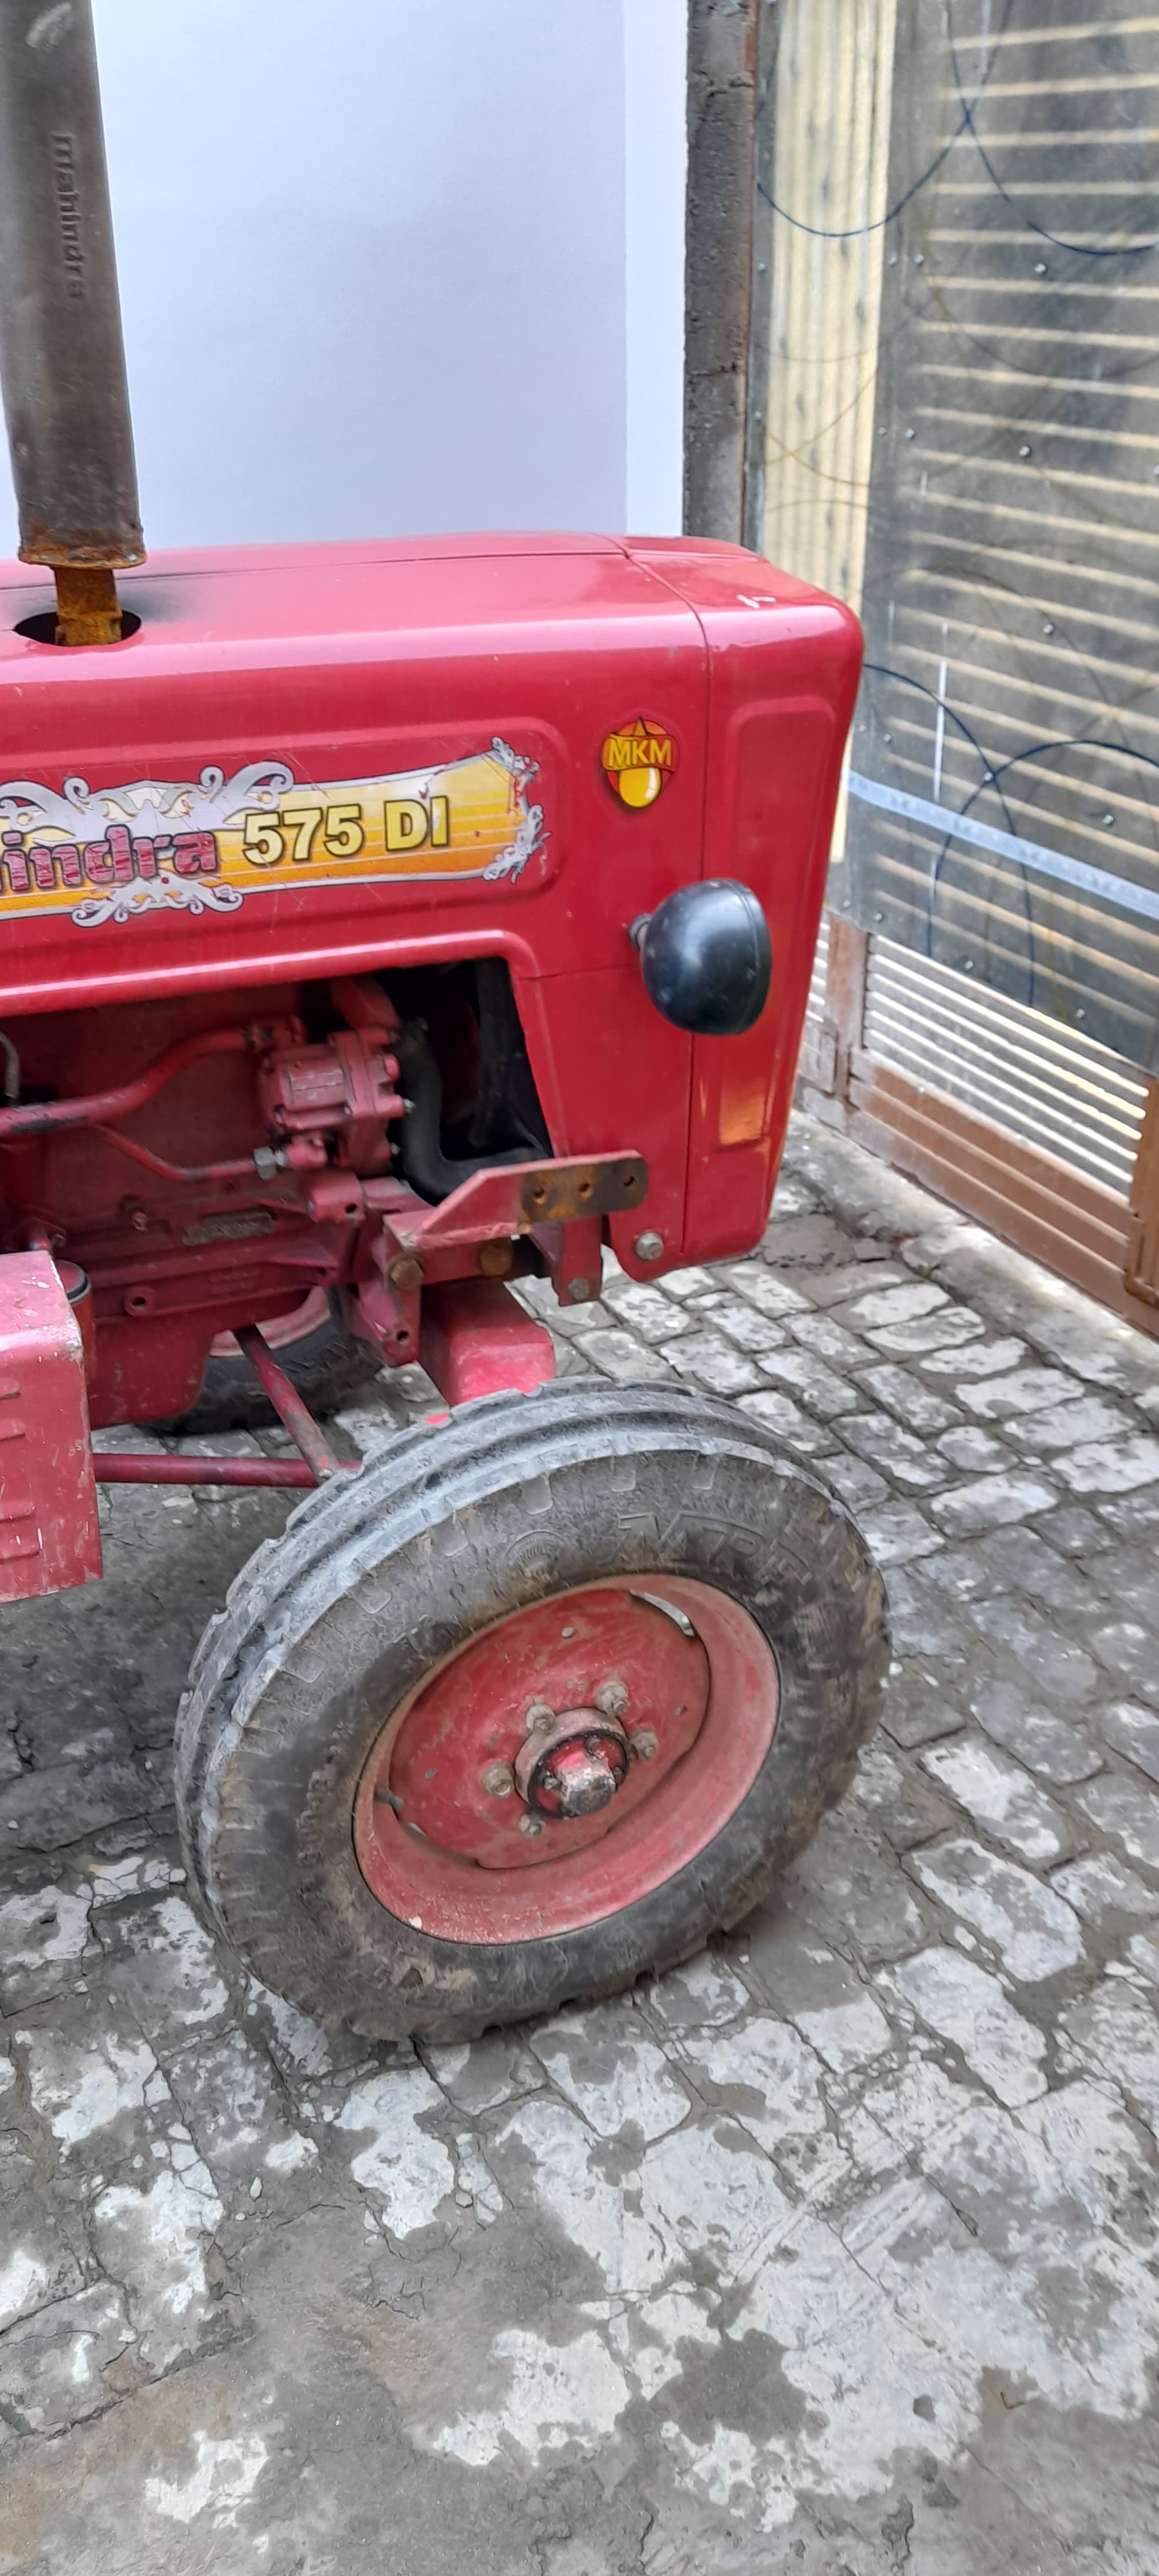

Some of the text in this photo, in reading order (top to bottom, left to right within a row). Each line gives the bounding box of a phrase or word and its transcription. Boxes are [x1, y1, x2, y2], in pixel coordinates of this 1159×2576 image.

[53, 133, 85, 298] mahindra
[607, 738, 672, 768] MKM
[0, 795, 449, 891] indra 575 DI
